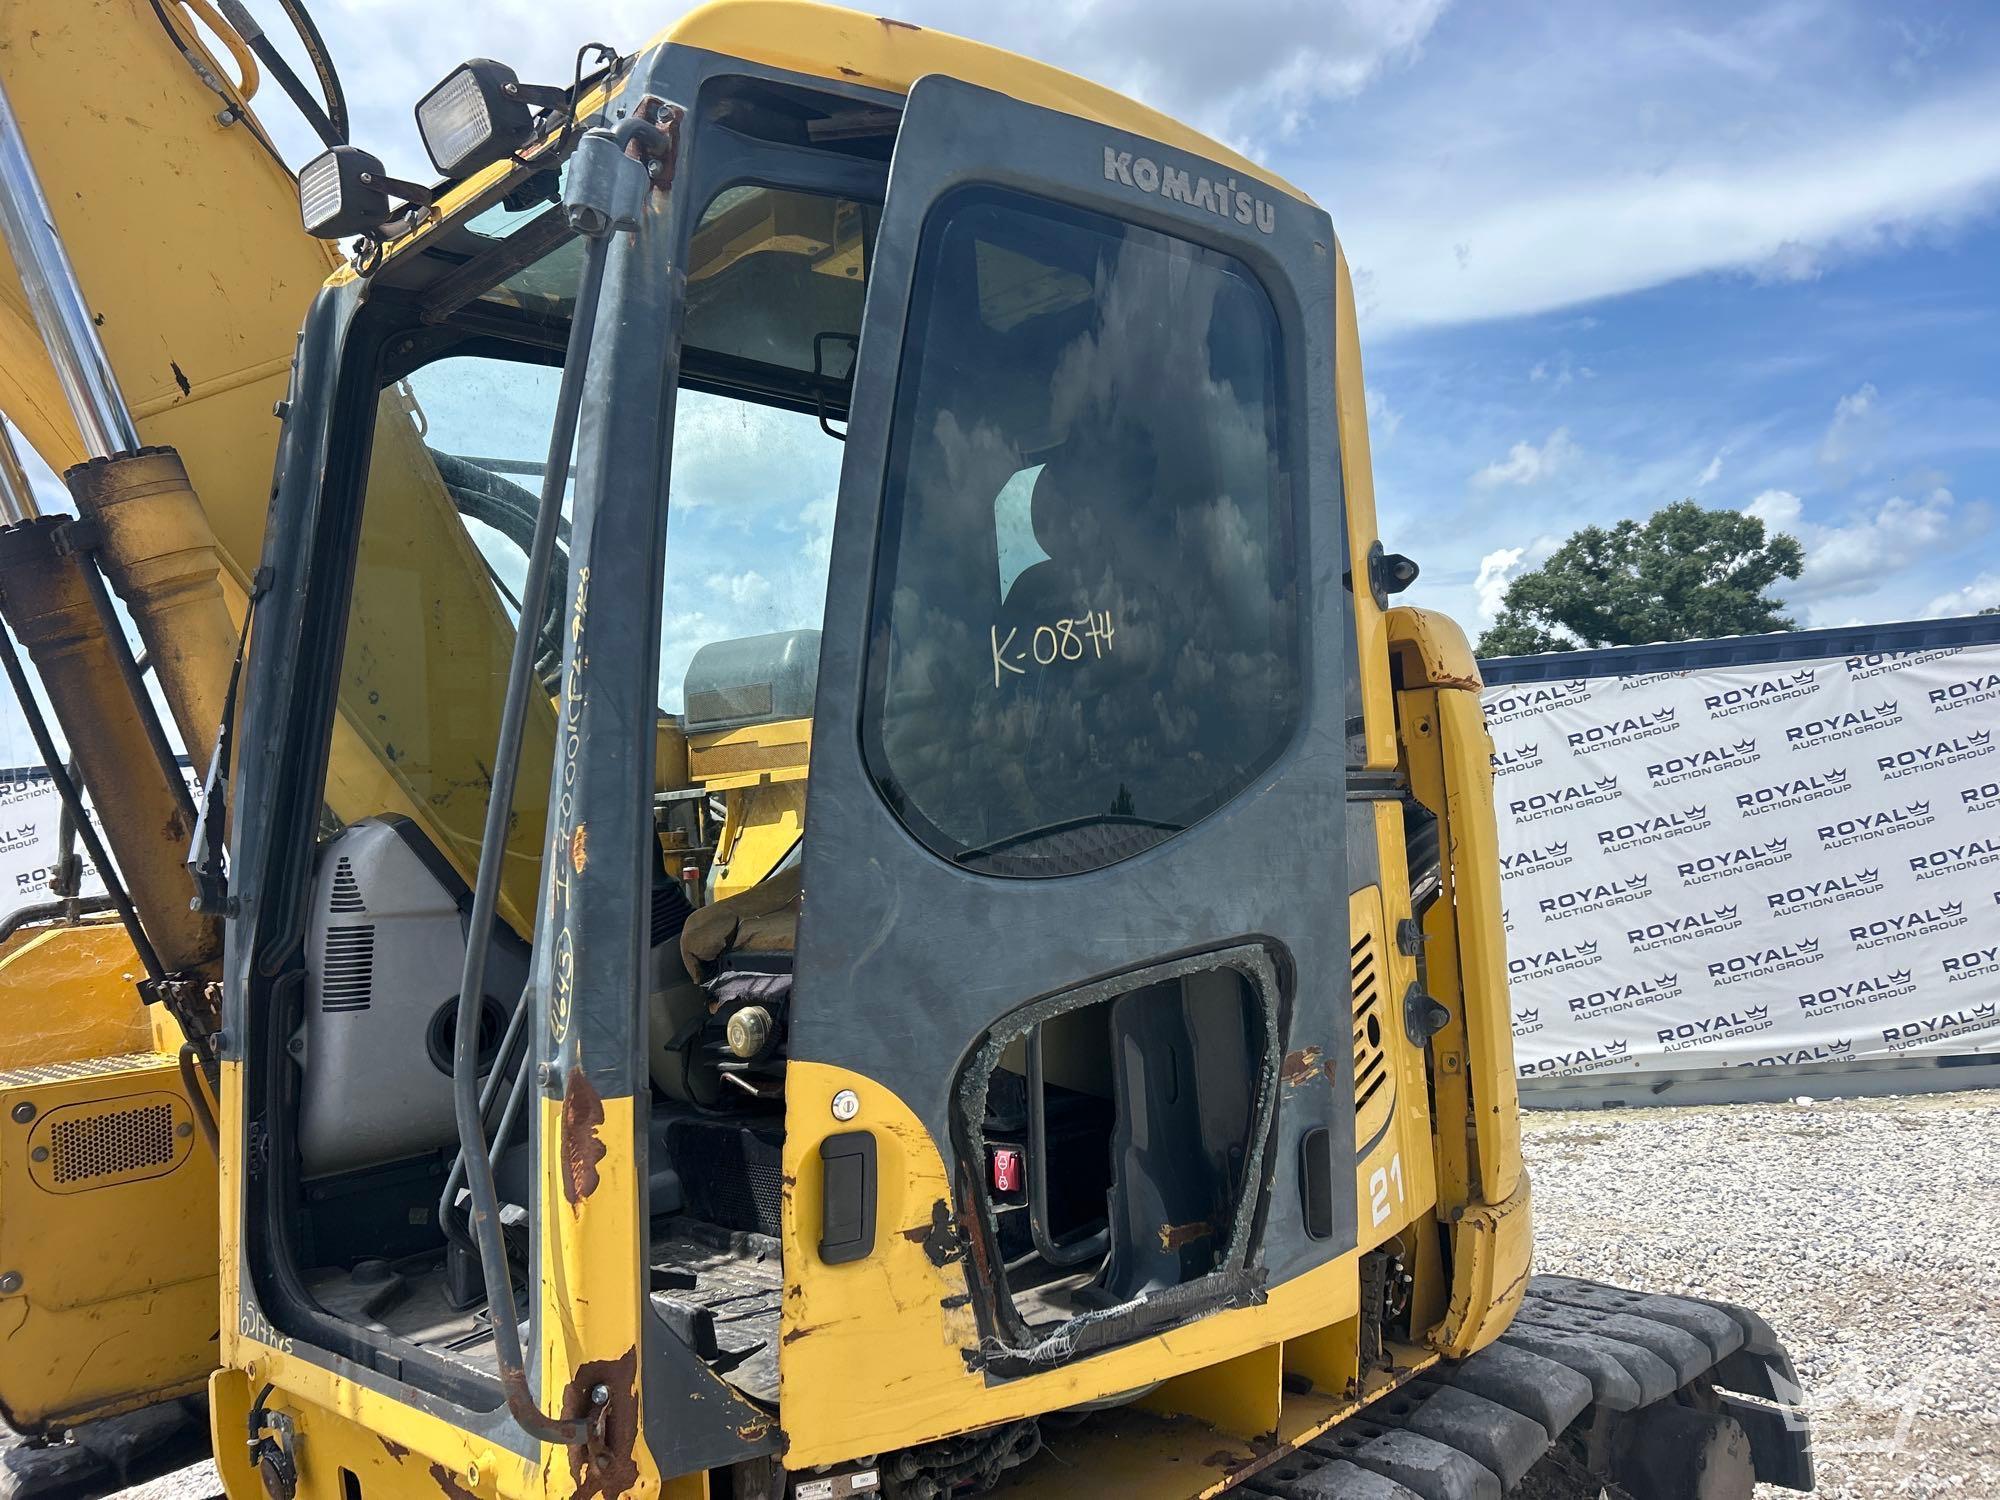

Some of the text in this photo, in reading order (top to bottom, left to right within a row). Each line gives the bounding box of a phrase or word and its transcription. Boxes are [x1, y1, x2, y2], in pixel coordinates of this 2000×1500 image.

[1104, 146, 1275, 234] KOMATSU
[1622, 671, 1680, 691] AUCTION
[1852, 648, 1963, 681] AUCTION GROUP
[1482, 687, 1566, 717] ROYAL
[1704, 678, 1793, 711] ROYAL
[1710, 684, 1820, 720] AUCTION GROUP
[1928, 674, 2000, 703] ROYA
[1935, 691, 1996, 714] AUCTION
[1486, 693, 1592, 726] AUCTION GROUP
[1785, 708, 1876, 742] ROYAL
[1567, 715, 1654, 747] ROYAL
[1573, 721, 1681, 757] AUCTION GROUP
[1791, 715, 1903, 751] AUCTION GROUP
[1497, 758, 1543, 777] GROUP
[1646, 746, 1735, 778] ROYAL
[1652, 753, 1761, 788] AUCTION GROUP
[1877, 738, 1969, 772] ROYAL
[1883, 745, 1996, 781] AUCTION GROUP
[1, 786, 50, 806] AUCTION
[1509, 783, 1597, 815] ROYAL
[1515, 790, 1623, 824] AUCTION GROUP
[1736, 776, 1825, 809] ROYAL
[1742, 783, 1852, 818] AUCTION GROUP
[1597, 813, 1686, 845] ROYAL
[1602, 820, 1712, 855] AUCTION GROUP
[1817, 808, 1908, 841] ROYAL
[1823, 815, 1935, 851] AUCTION GROUP
[0, 837, 39, 853] GROUP
[1499, 848, 1548, 870] YAL
[1677, 845, 1766, 878] ROYAL
[1909, 839, 2000, 871] ROYAL
[1526, 856, 1573, 875] GROUP
[1683, 853, 1793, 887] AUCTION GROUP
[1915, 859, 1977, 881] AUCTION
[20, 881, 49, 895] AUCT
[1539, 880, 1627, 913] ROYAL
[1767, 876, 1857, 908] ROYAL
[1773, 883, 1884, 918] AUCTION GROUP
[1544, 889, 1653, 923] AUCTION GROUP
[1627, 912, 1716, 944] ROYAL
[1632, 919, 1743, 954] AUCTION GROUP
[1849, 908, 1941, 942] ROYAL
[1855, 917, 1968, 951] AUCTION GROUP
[1508, 948, 1577, 974] OYAL
[1510, 955, 1603, 986] CTION GROUP
[1707, 945, 1797, 978] ROYAL
[1713, 953, 1825, 988] AUCTION GROUP
[1942, 946, 1999, 973] ROY
[1948, 963, 2000, 983] AUCTIO
[1568, 981, 1657, 1012] ROYAL
[1574, 988, 1683, 1022] AUCTION GROUP
[1798, 976, 1890, 1009] ROYAL
[1804, 984, 1917, 1019] AUCTION GROUP
[1514, 1023, 1544, 1037] OUP
[1657, 1012, 1746, 1044] ROYAL
[1663, 1020, 1774, 1054] AUCTION GROUP
[1882, 1010, 1974, 1043] ROYAL
[1888, 1018, 2000, 1053] AUCTION GROUP
[1519, 1047, 1606, 1077] ROYAL
[1585, 1055, 1633, 1071] GROUP
[1369, 1152, 1404, 1228] 21
